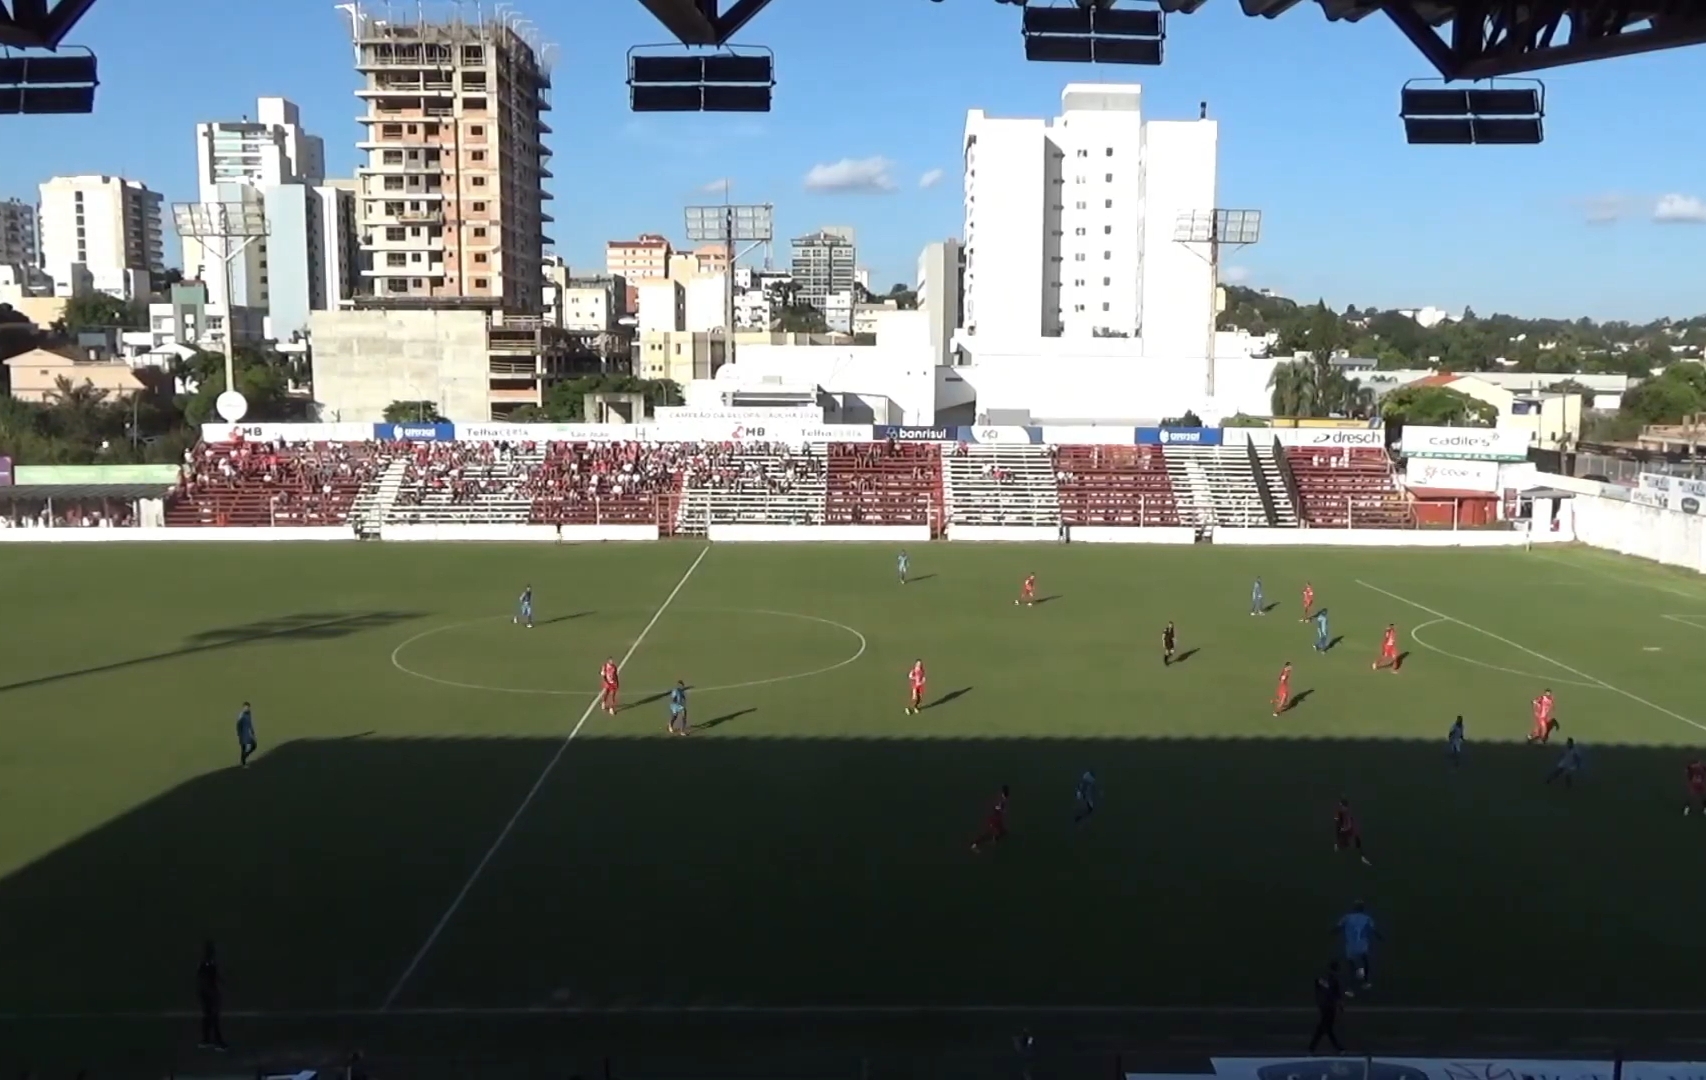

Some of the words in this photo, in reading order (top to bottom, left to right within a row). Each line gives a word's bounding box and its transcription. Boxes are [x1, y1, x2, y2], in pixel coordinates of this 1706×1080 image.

[745, 427, 765, 437] MB
[899, 428, 947, 439] banrisul
[1332, 430, 1381, 444] dresch
